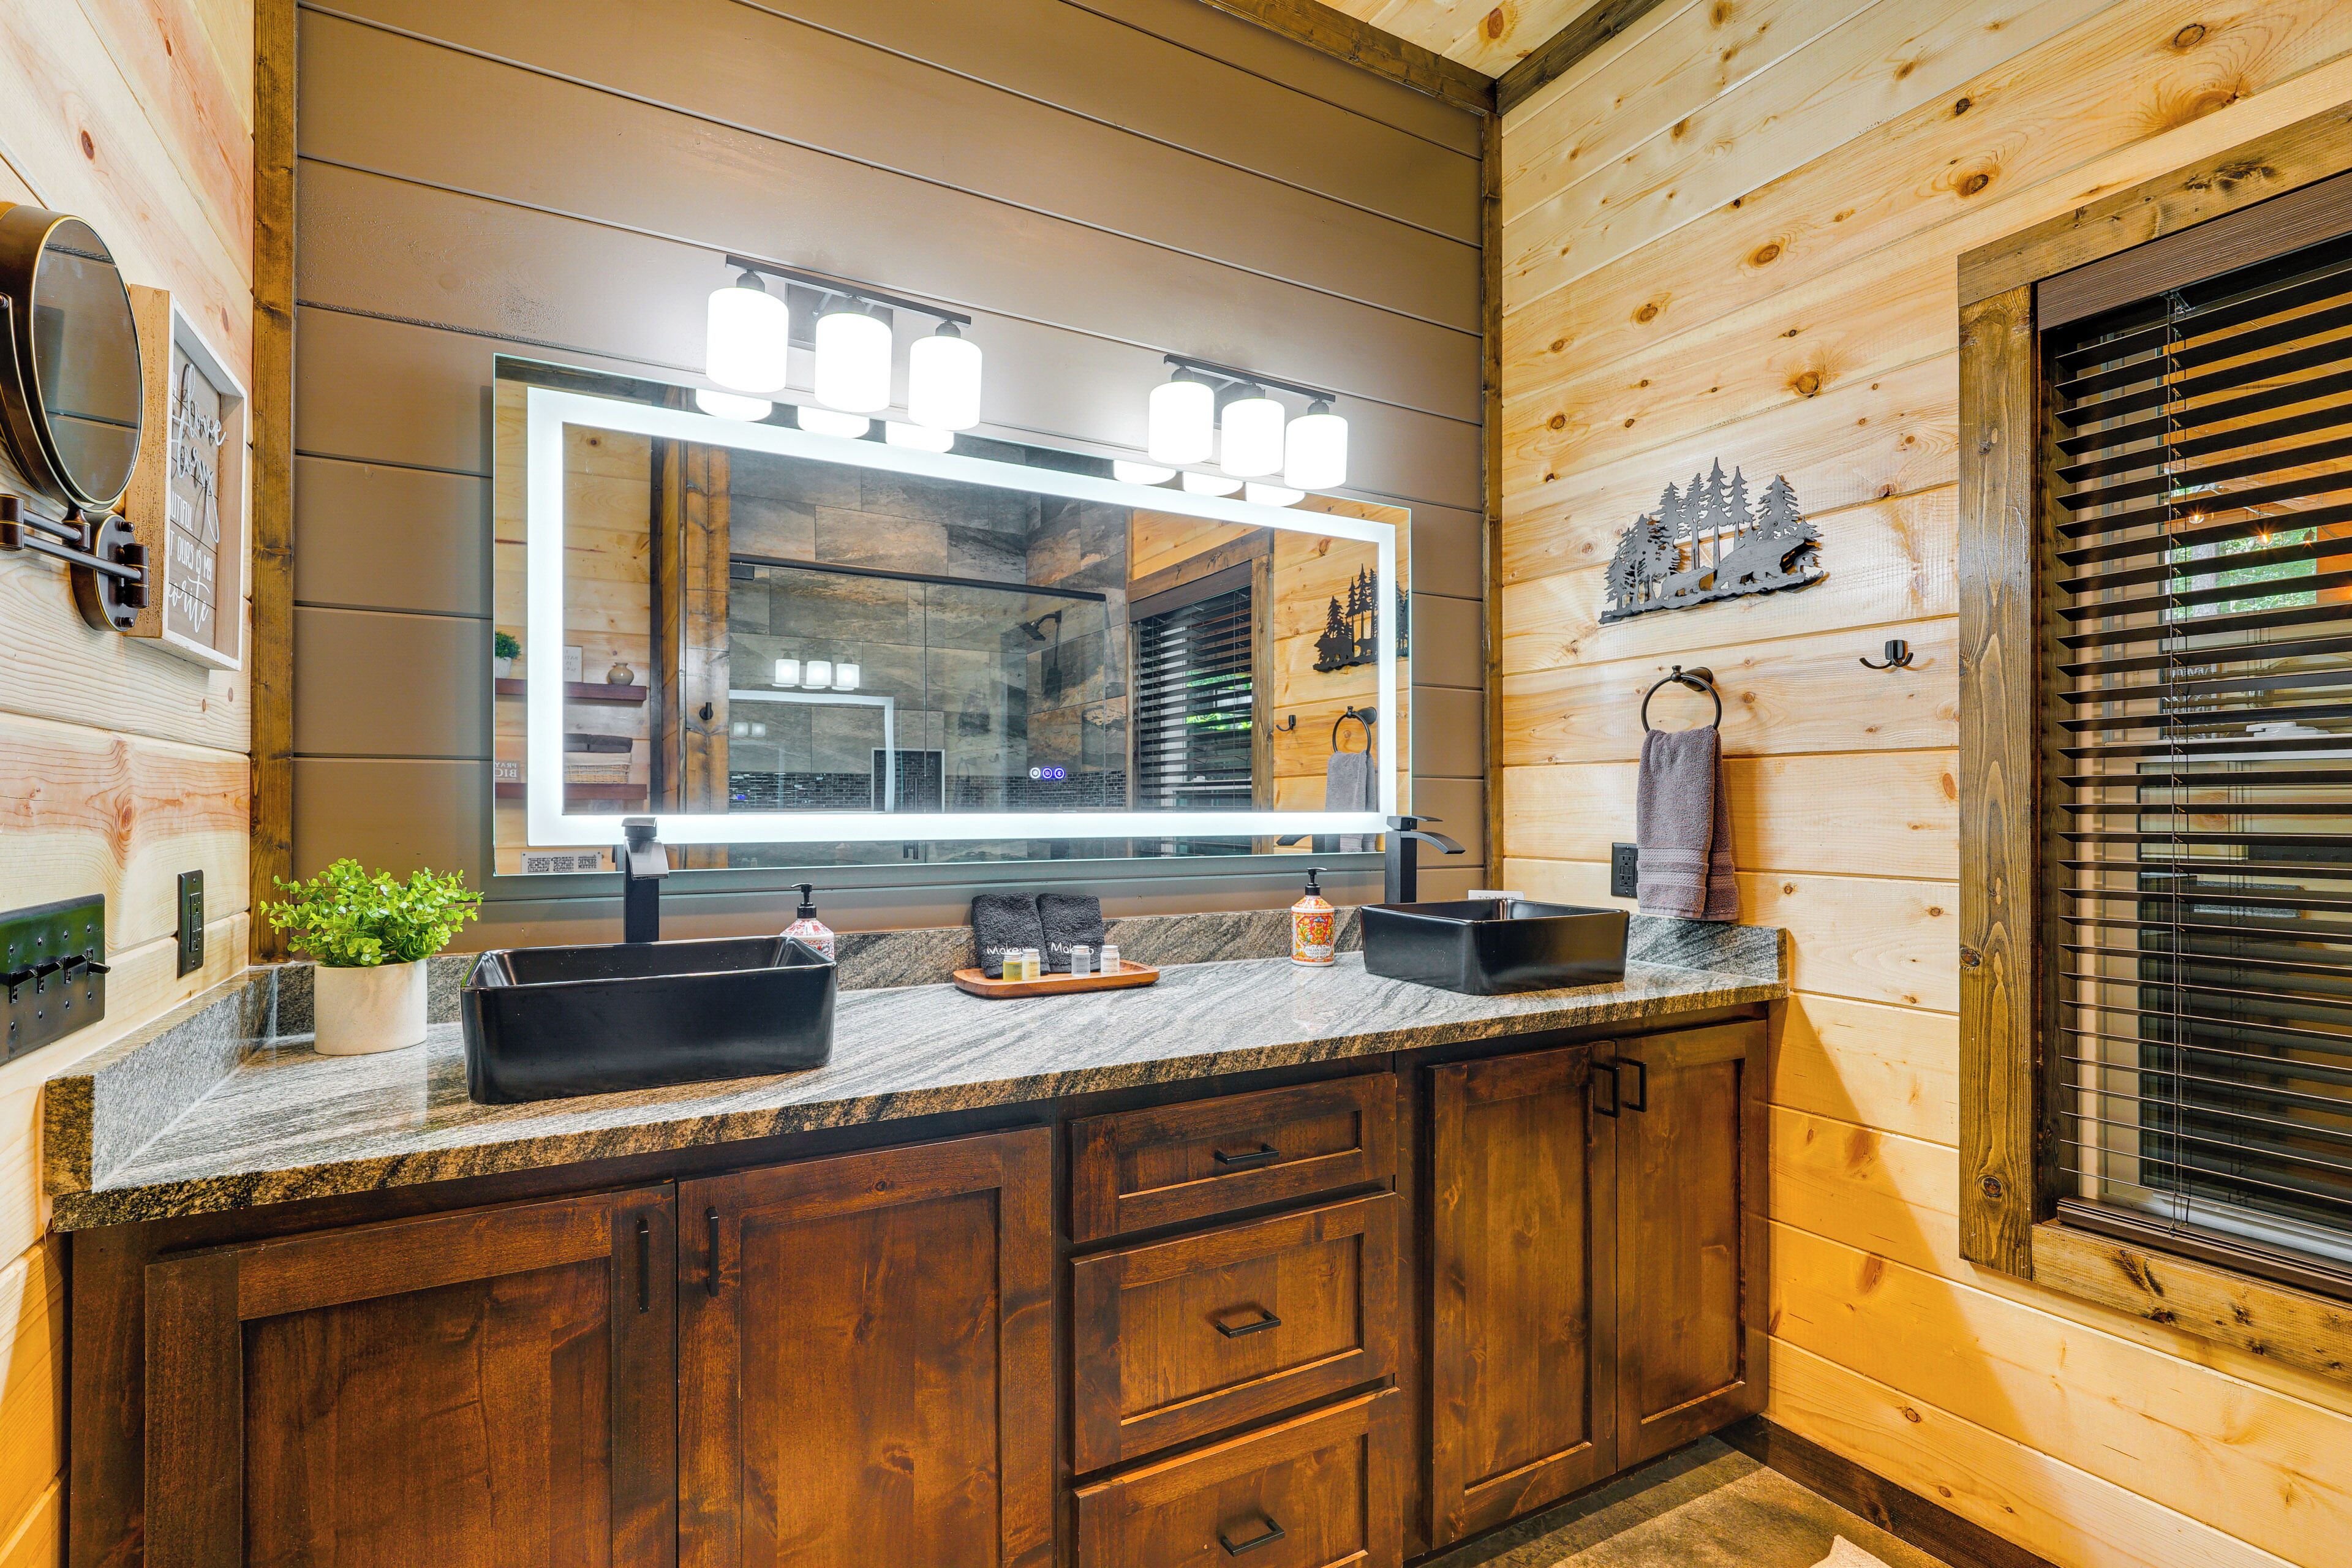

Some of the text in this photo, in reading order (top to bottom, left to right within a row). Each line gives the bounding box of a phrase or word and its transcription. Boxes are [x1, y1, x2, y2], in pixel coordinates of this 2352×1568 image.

[170, 491, 193, 532] UTIFUL
[177, 535, 194, 570] OURS
[195, 548, 202, 575] IS
[203, 554, 213, 582] MY
